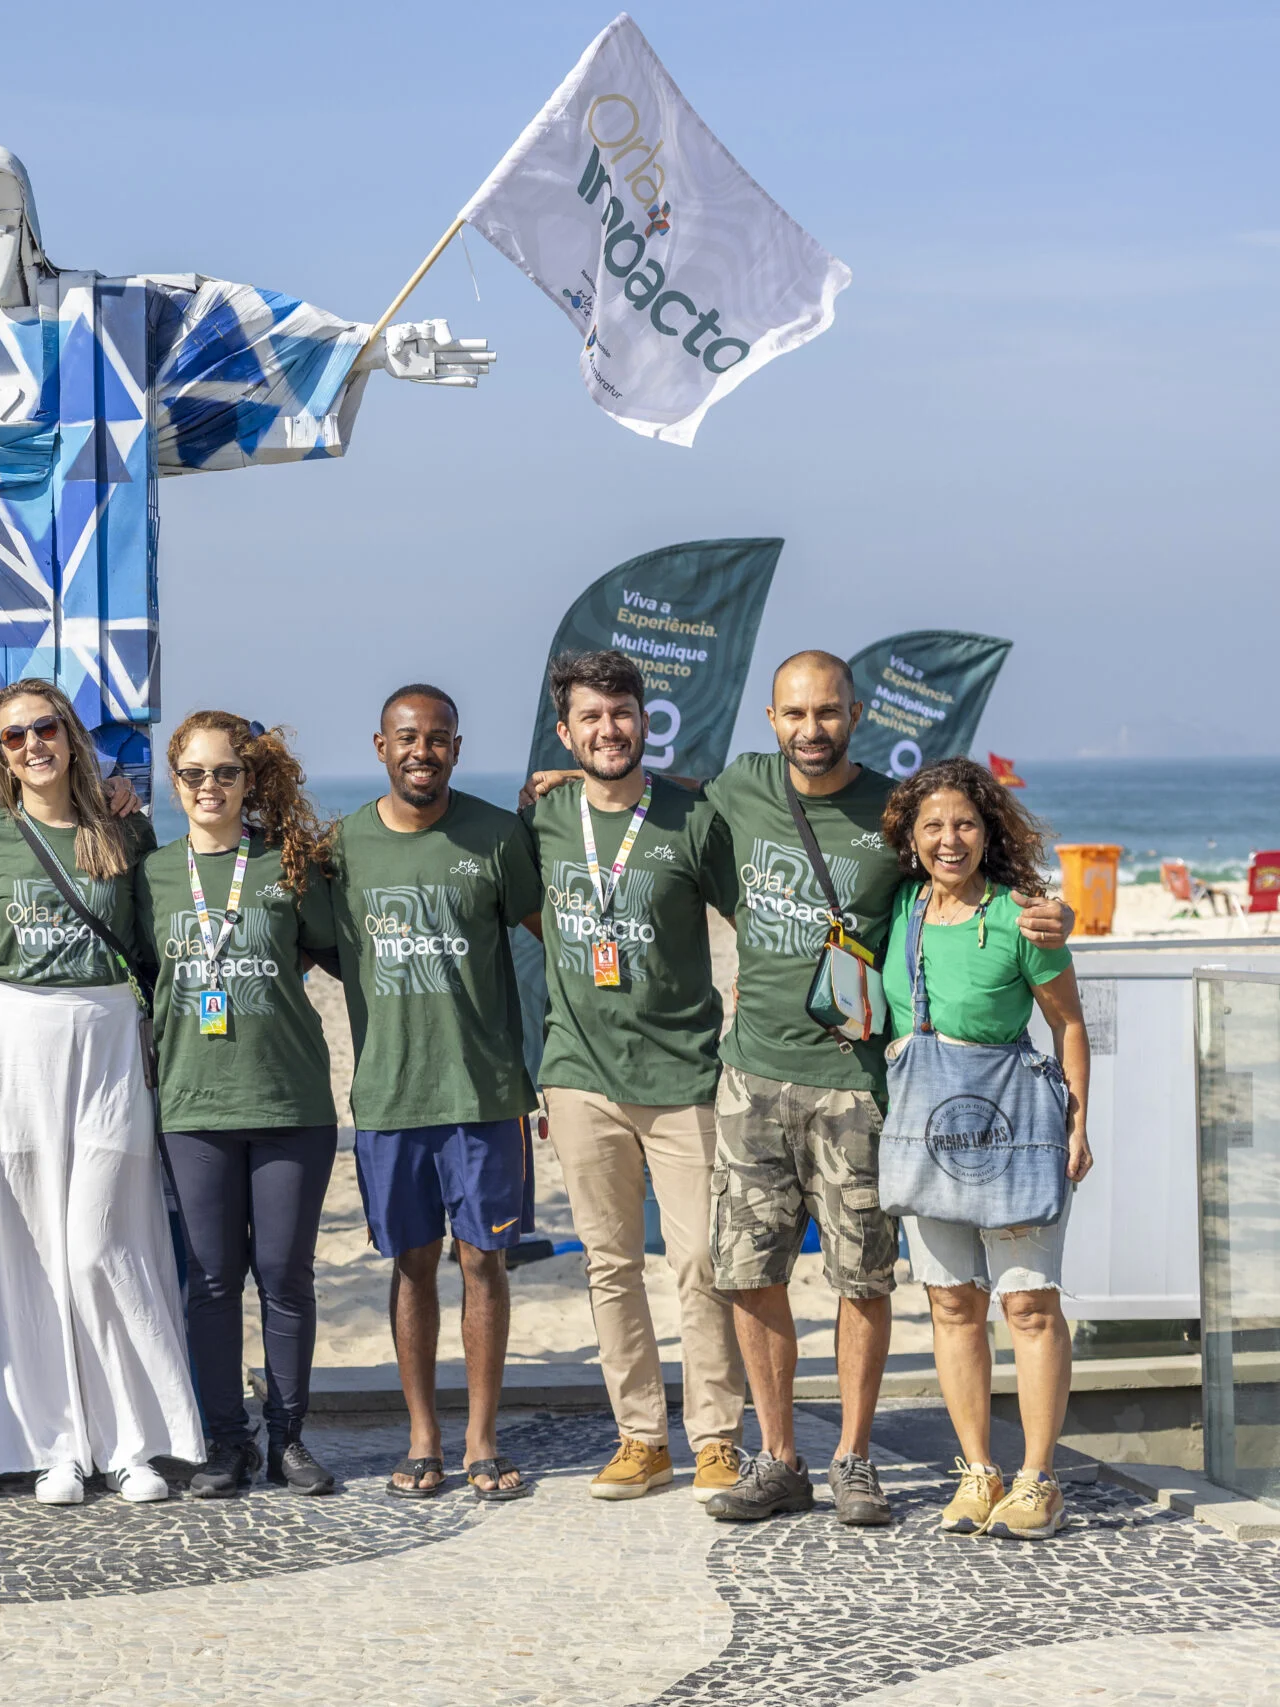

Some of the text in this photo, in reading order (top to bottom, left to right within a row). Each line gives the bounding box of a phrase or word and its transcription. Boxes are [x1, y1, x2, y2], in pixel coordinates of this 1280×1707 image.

[587, 94, 665, 212] Orla
[577, 143, 750, 374] Impacto
[622, 590, 671, 614] Viva a
[617, 607, 718, 637] Experiência.
[611, 632, 708, 662] Multiplique
[890, 654, 924, 680] Viva a
[871, 699, 880, 709] o
[876, 684, 946, 720] Multiplique
[868, 709, 919, 738] Positivo.
[740, 863, 781, 893] Orla
[547, 885, 581, 910] Orla
[6, 900, 49, 924] Orla
[365, 912, 398, 935] Orla
[14, 924, 92, 951] Impac
[164, 934, 203, 958] Orla
[372, 933, 469, 962] Impacto
[174, 955, 279, 984] mpacto
[932, 1126, 1008, 1152] PRAIAS LIMPAS
